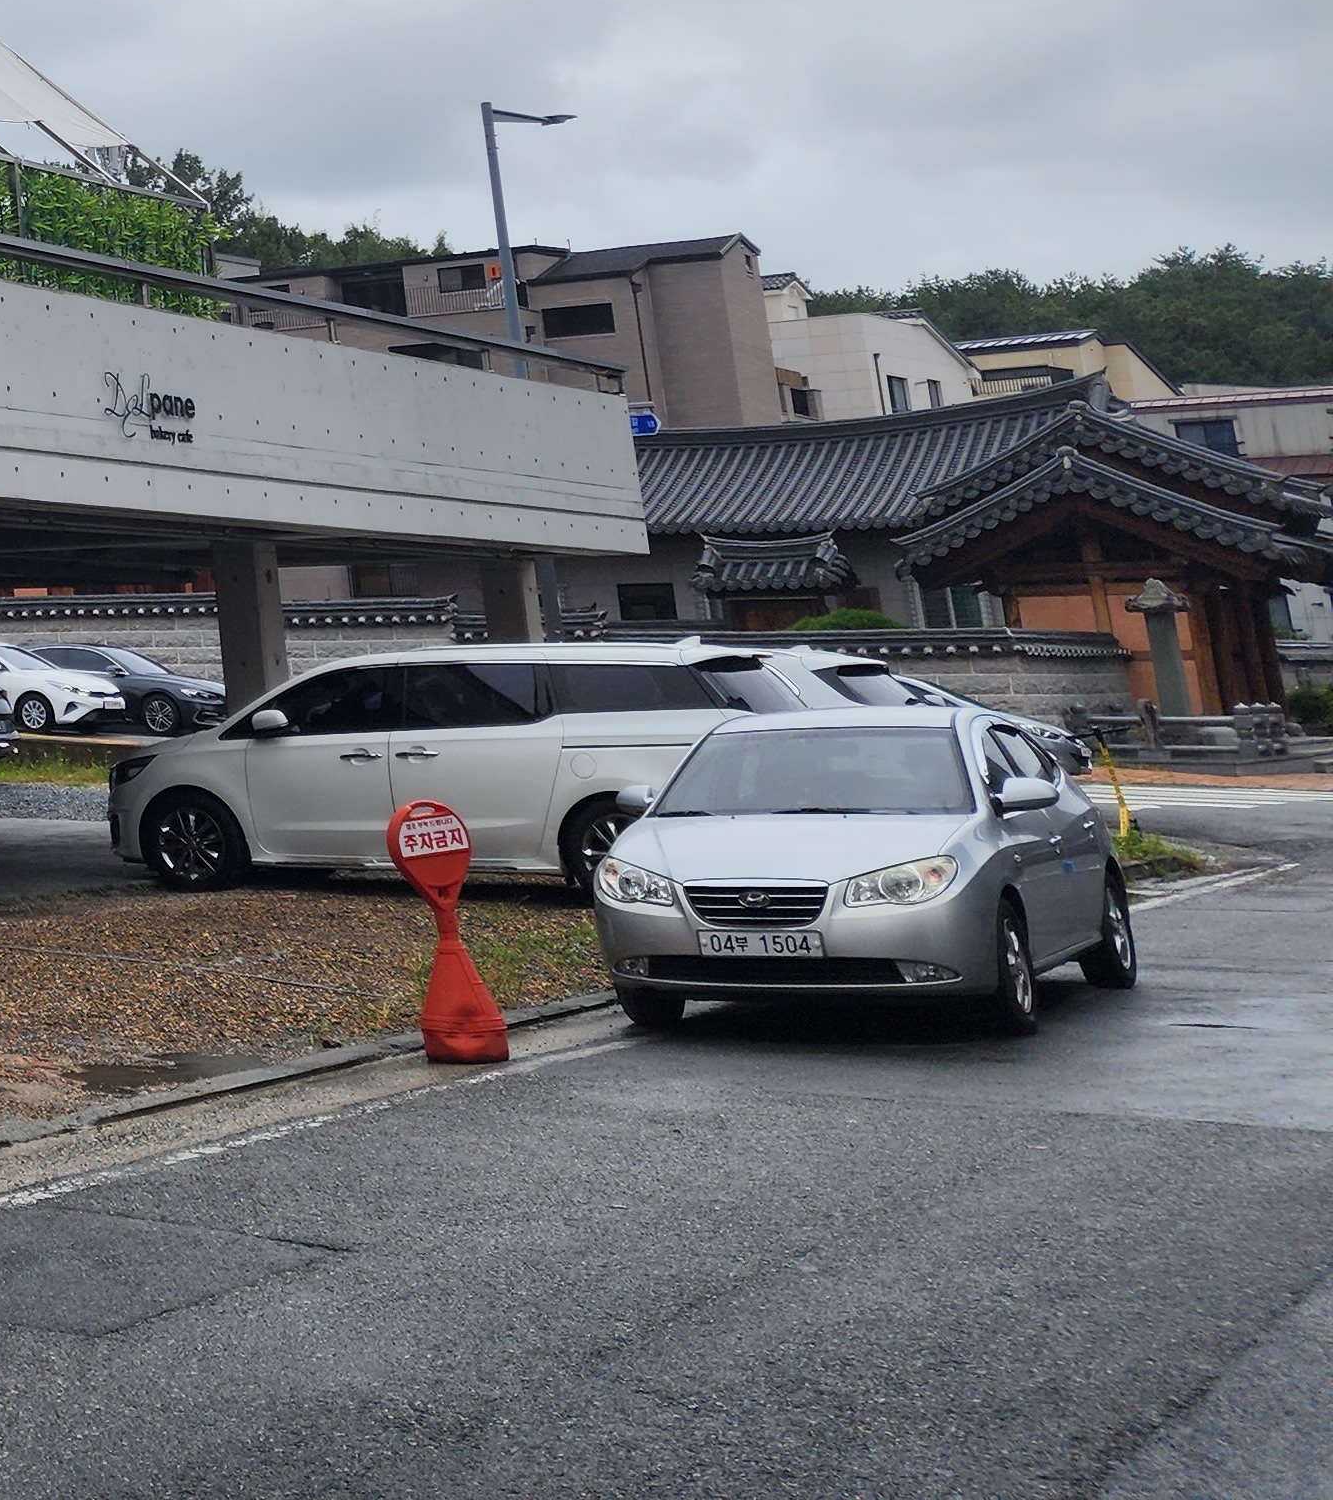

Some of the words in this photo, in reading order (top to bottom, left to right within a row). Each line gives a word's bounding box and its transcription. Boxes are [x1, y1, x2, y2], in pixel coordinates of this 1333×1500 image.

[177, 429, 193, 444] cafe
[404, 828, 463, 852] 주차금지
[710, 934, 748, 953] 04부
[759, 934, 811, 953] 1504
